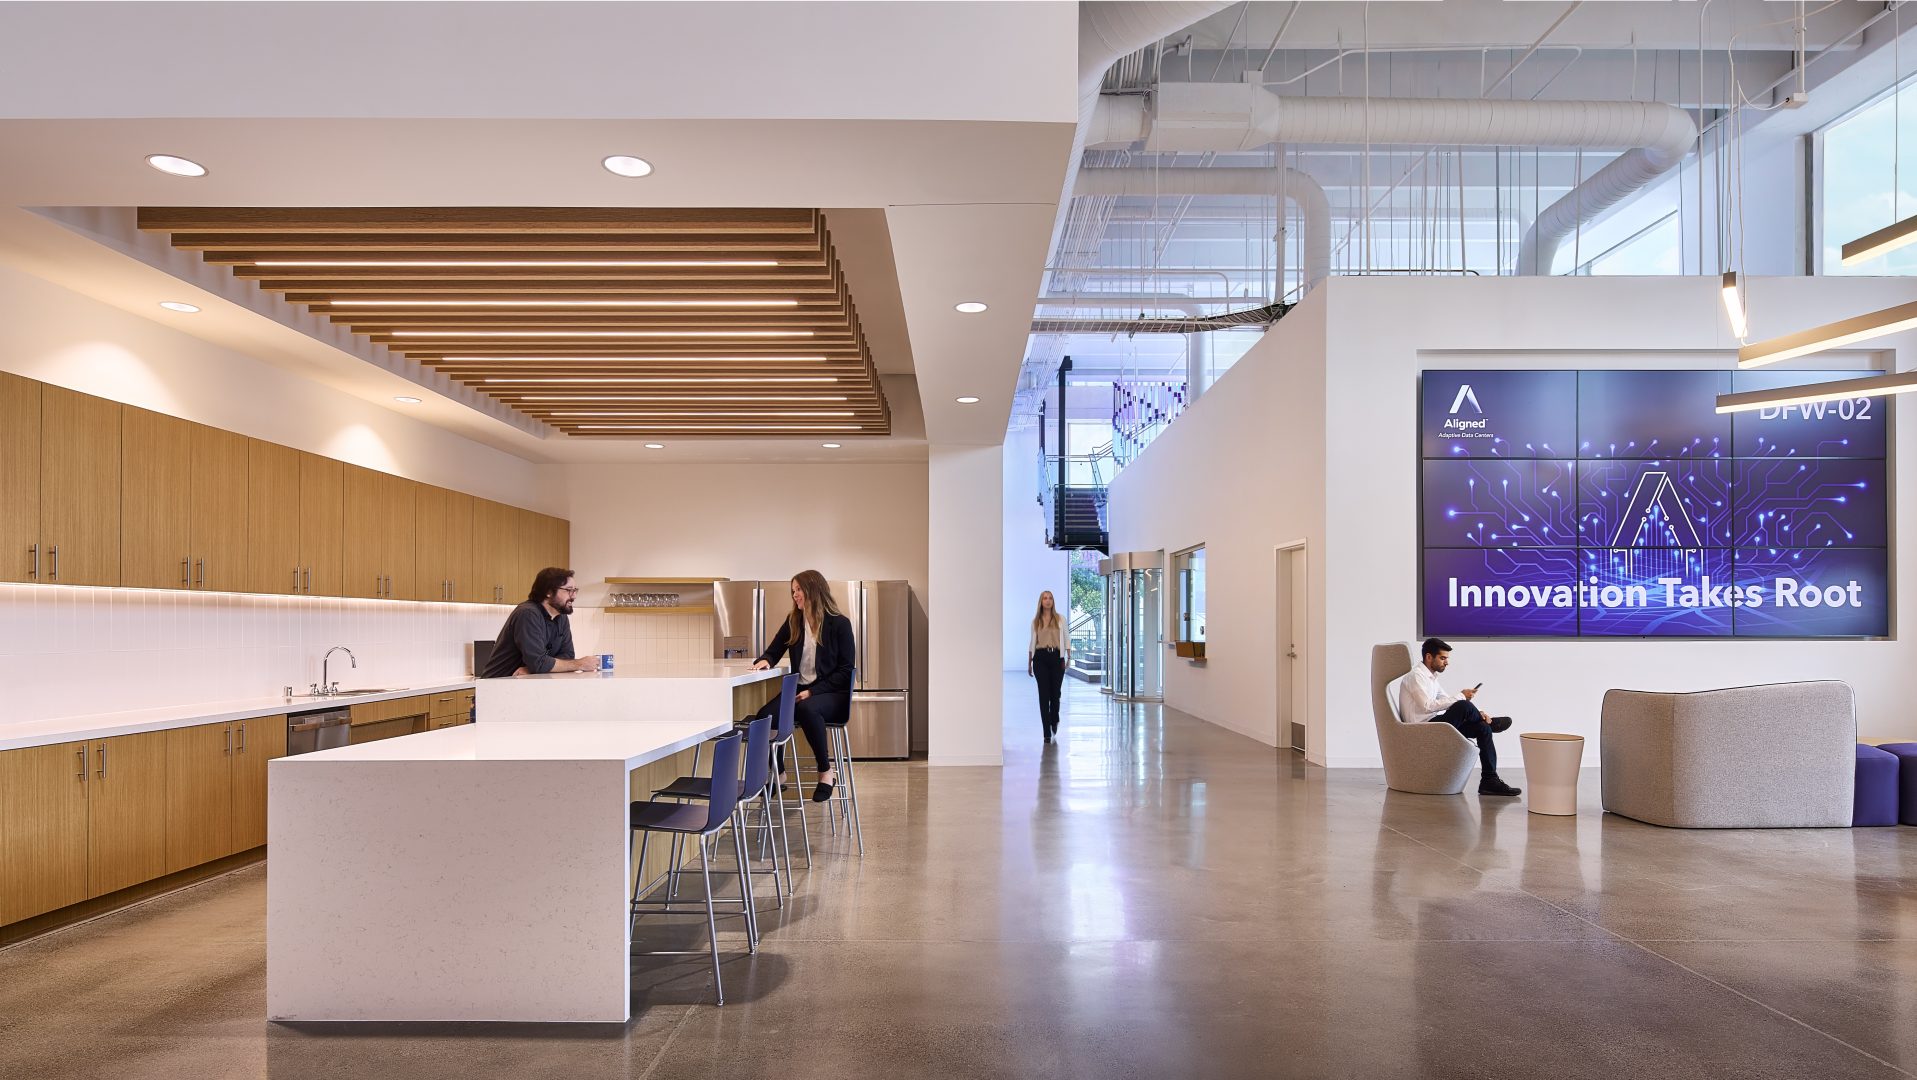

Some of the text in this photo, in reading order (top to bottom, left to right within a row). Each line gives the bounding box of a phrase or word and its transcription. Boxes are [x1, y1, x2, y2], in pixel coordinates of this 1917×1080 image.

[1760, 397, 1871, 420] DFW-02
[1444, 418, 1486, 431] Aligned
[1448, 576, 1862, 608] Innovation Takes Root
